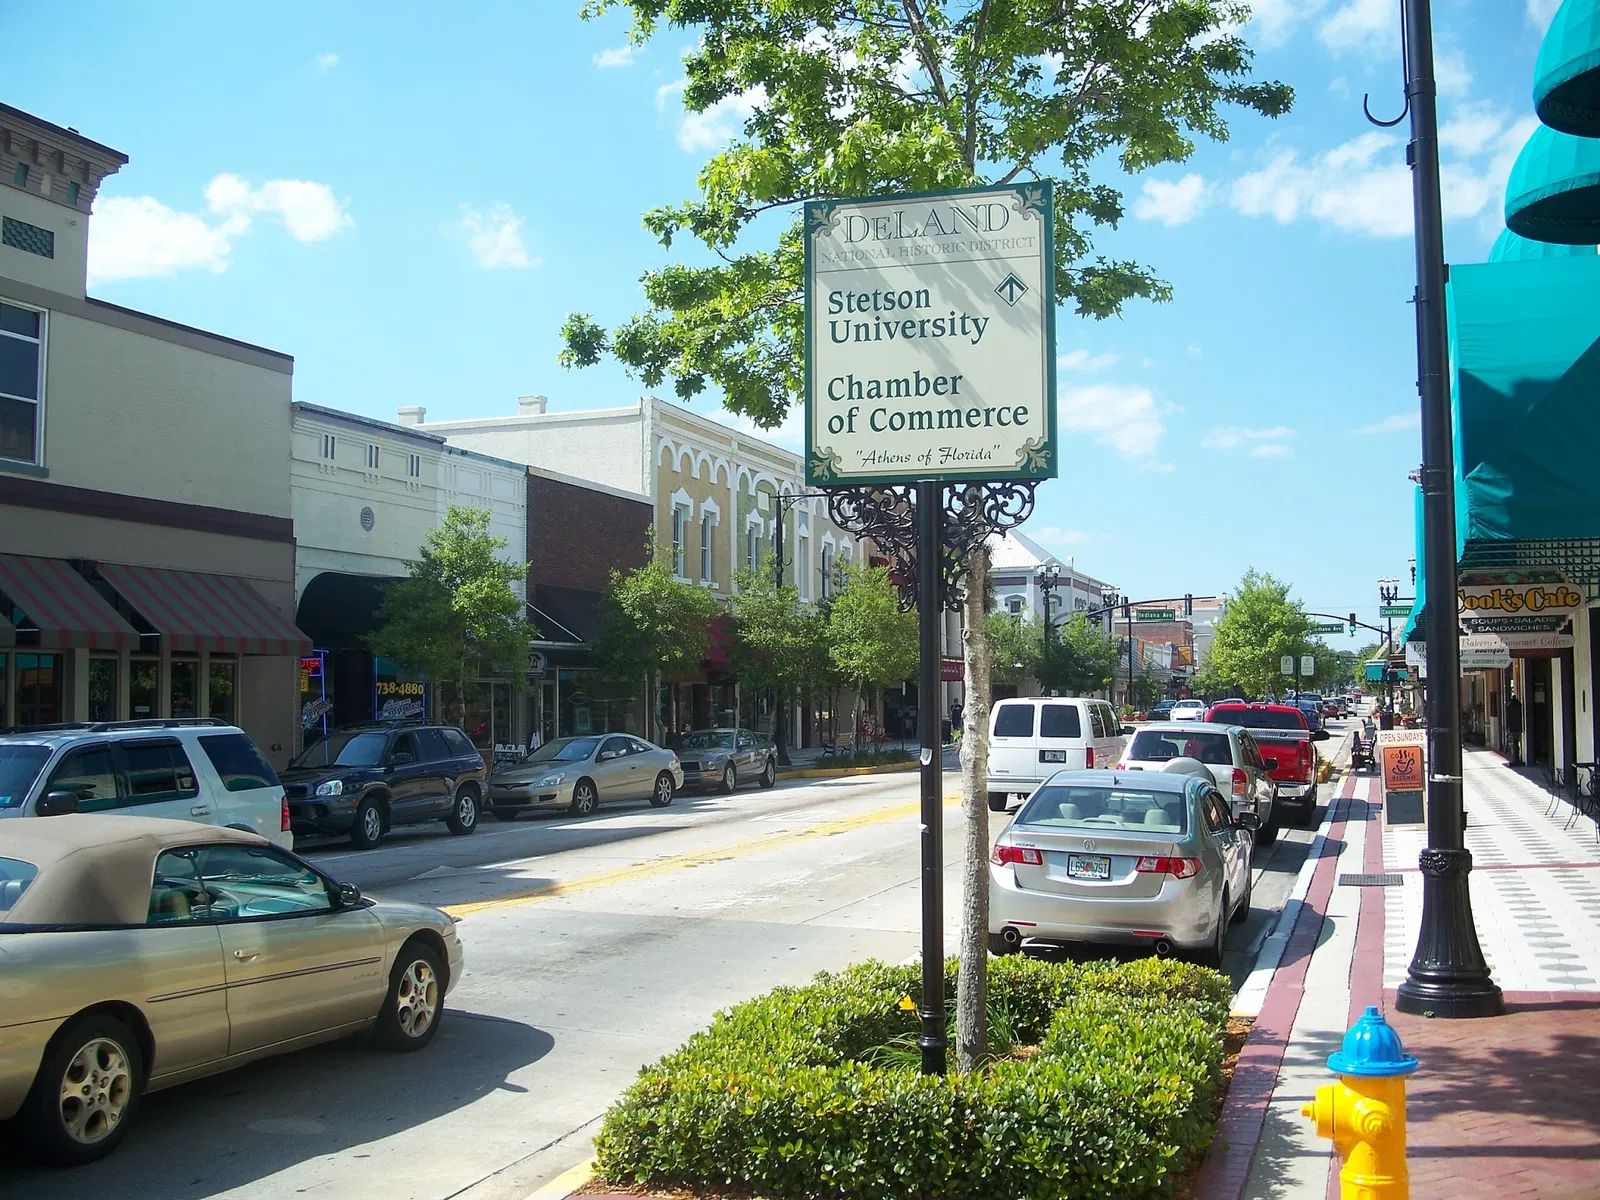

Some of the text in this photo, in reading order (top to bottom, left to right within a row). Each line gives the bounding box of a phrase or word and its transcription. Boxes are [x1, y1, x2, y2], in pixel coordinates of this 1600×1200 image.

[821, 236, 1036, 264] NATIONAL HISTORIC DISTRICT
[828, 288, 932, 315] Stetson
[829, 311, 990, 345] University
[827, 370, 963, 402] Chamber
[827, 404, 1030, 434] of Commerce
[856, 444, 1001, 467] "Athens of Florida"
[1525, 586, 1581, 612] Cafe
[1477, 624, 1551, 632] SANDWICHES
[1461, 636, 1571, 648] Bakery Gourmet Coffees
[1380, 732, 1424, 742] OPEN SUNDAYS
